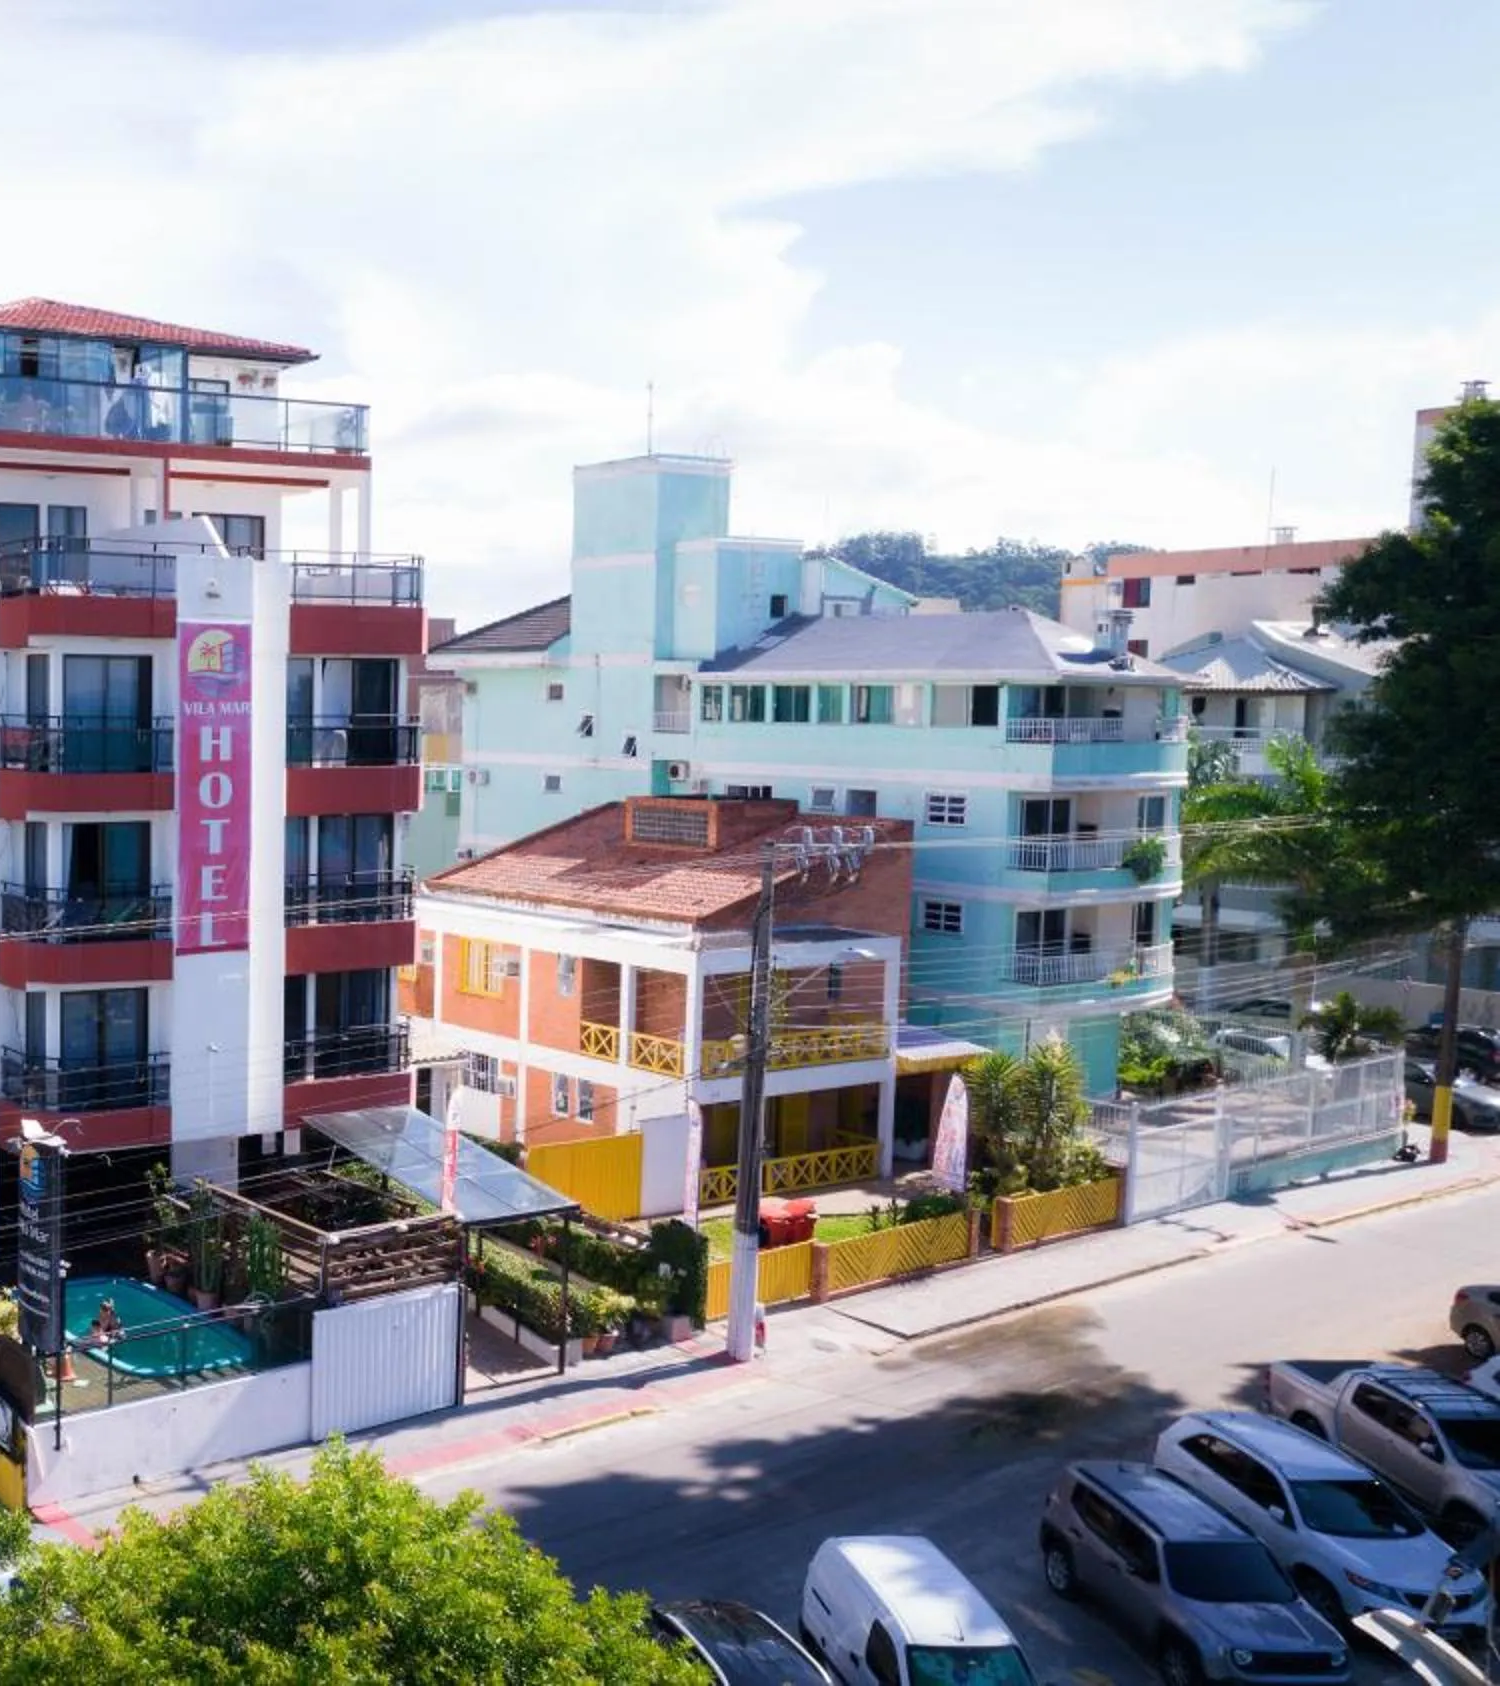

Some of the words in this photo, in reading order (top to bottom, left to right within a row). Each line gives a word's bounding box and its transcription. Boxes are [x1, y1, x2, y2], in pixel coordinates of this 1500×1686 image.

[183, 701, 215, 716] VILA
[220, 701, 251, 716] MAR
[199, 726, 233, 945] HOTEL
